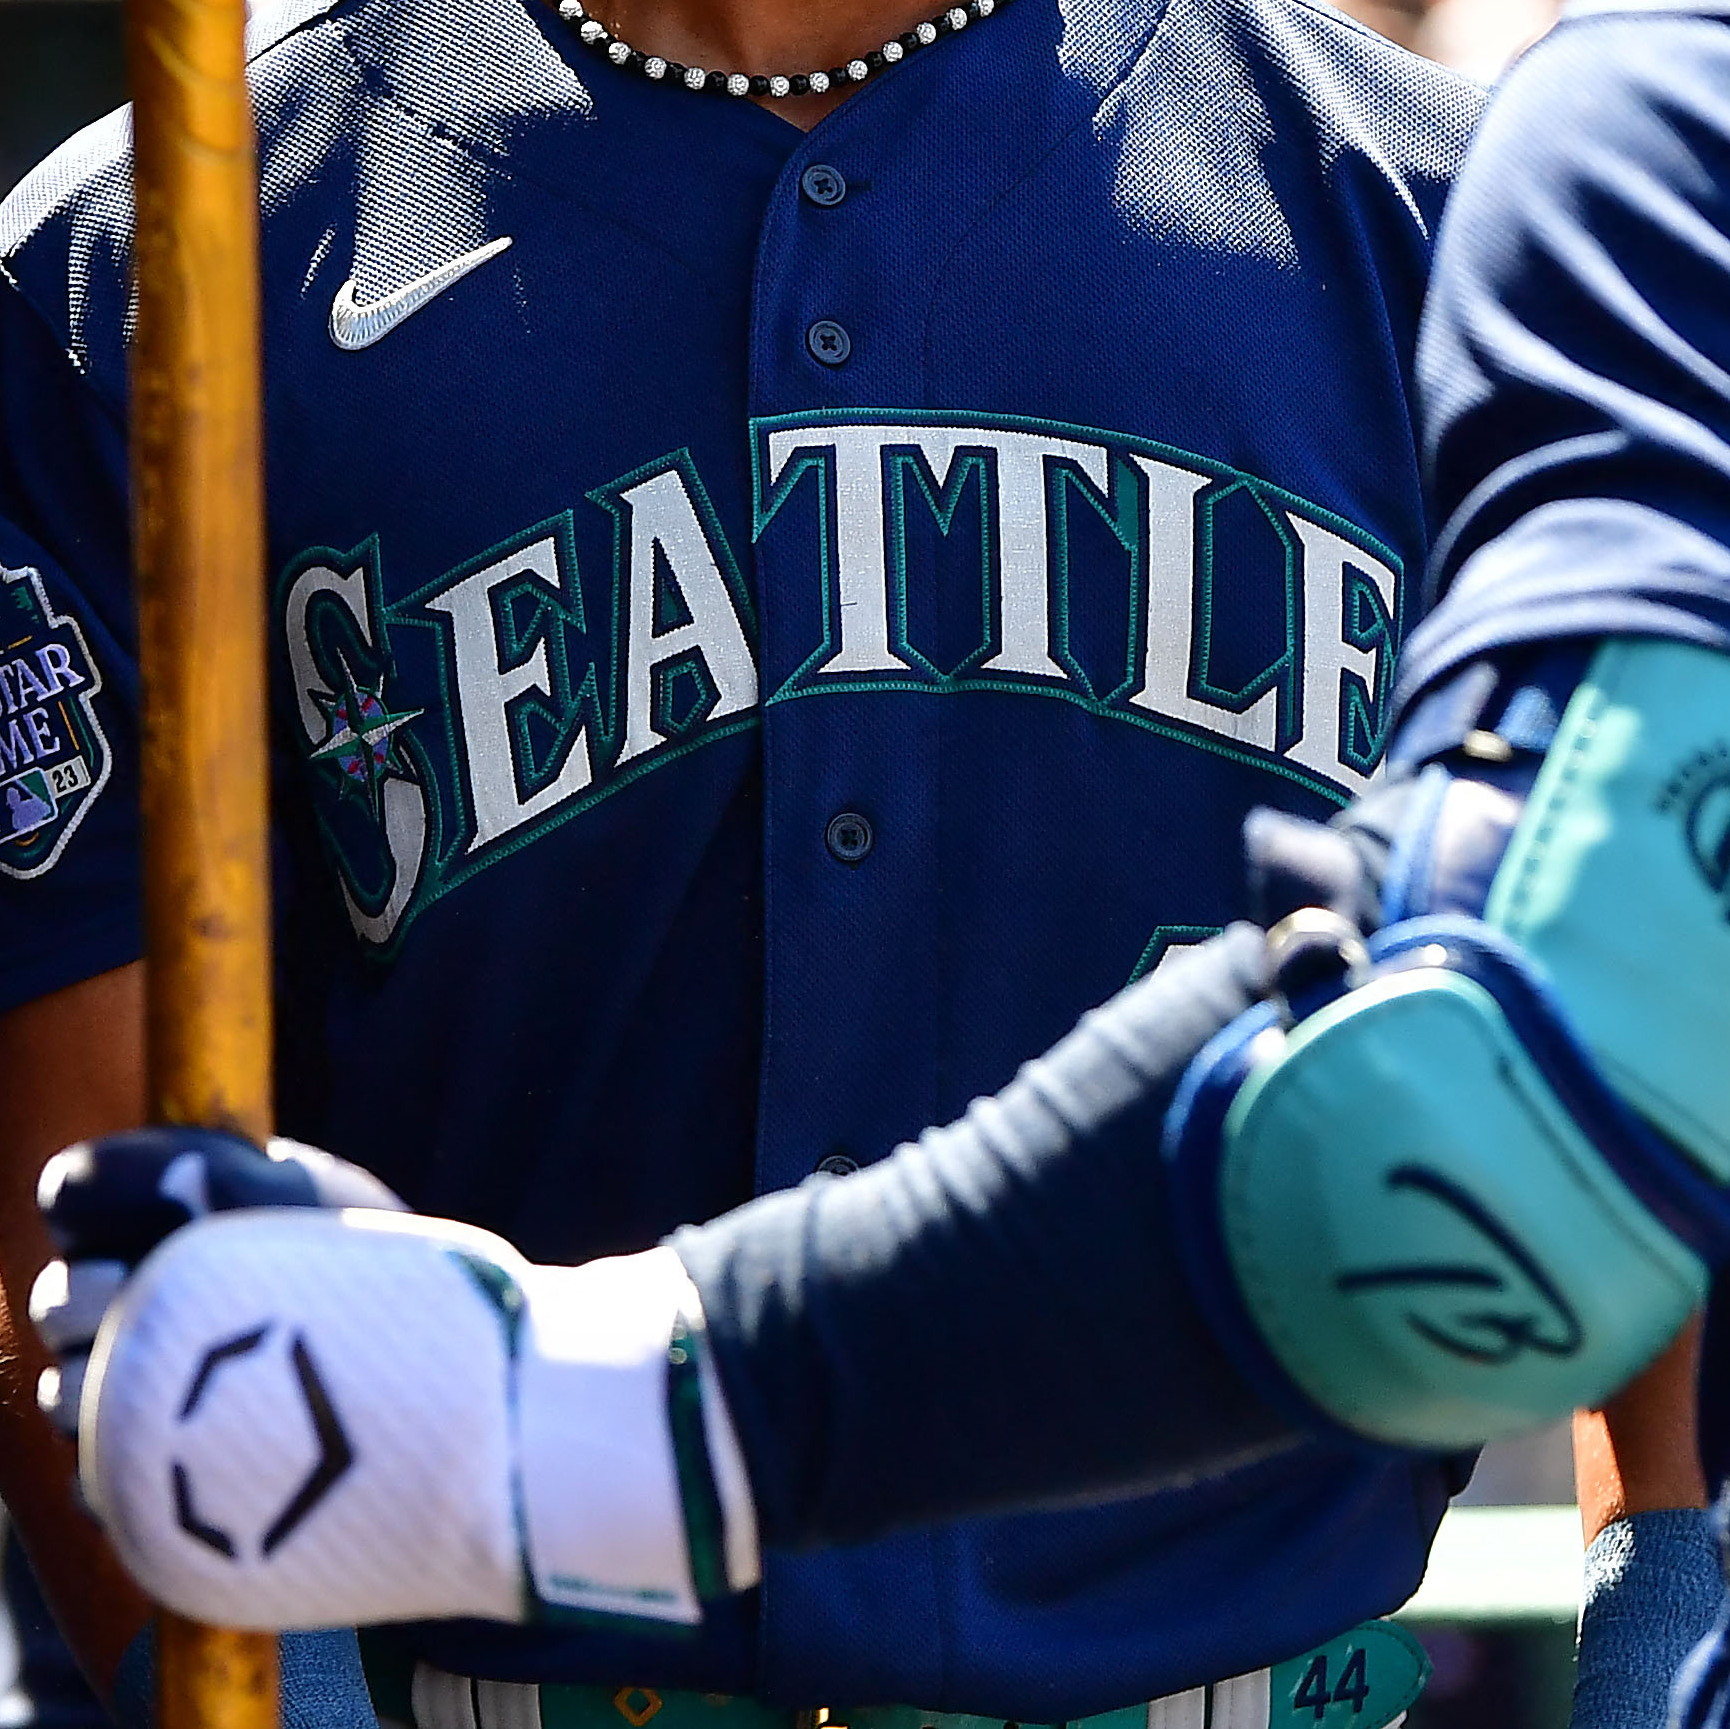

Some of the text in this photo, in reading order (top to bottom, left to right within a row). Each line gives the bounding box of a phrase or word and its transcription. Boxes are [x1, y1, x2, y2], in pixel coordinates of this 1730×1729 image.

[279, 415, 1401, 955] SEATTLE
[51, 763, 80, 794] 23
[1291, 1647, 1371, 1720] 44
